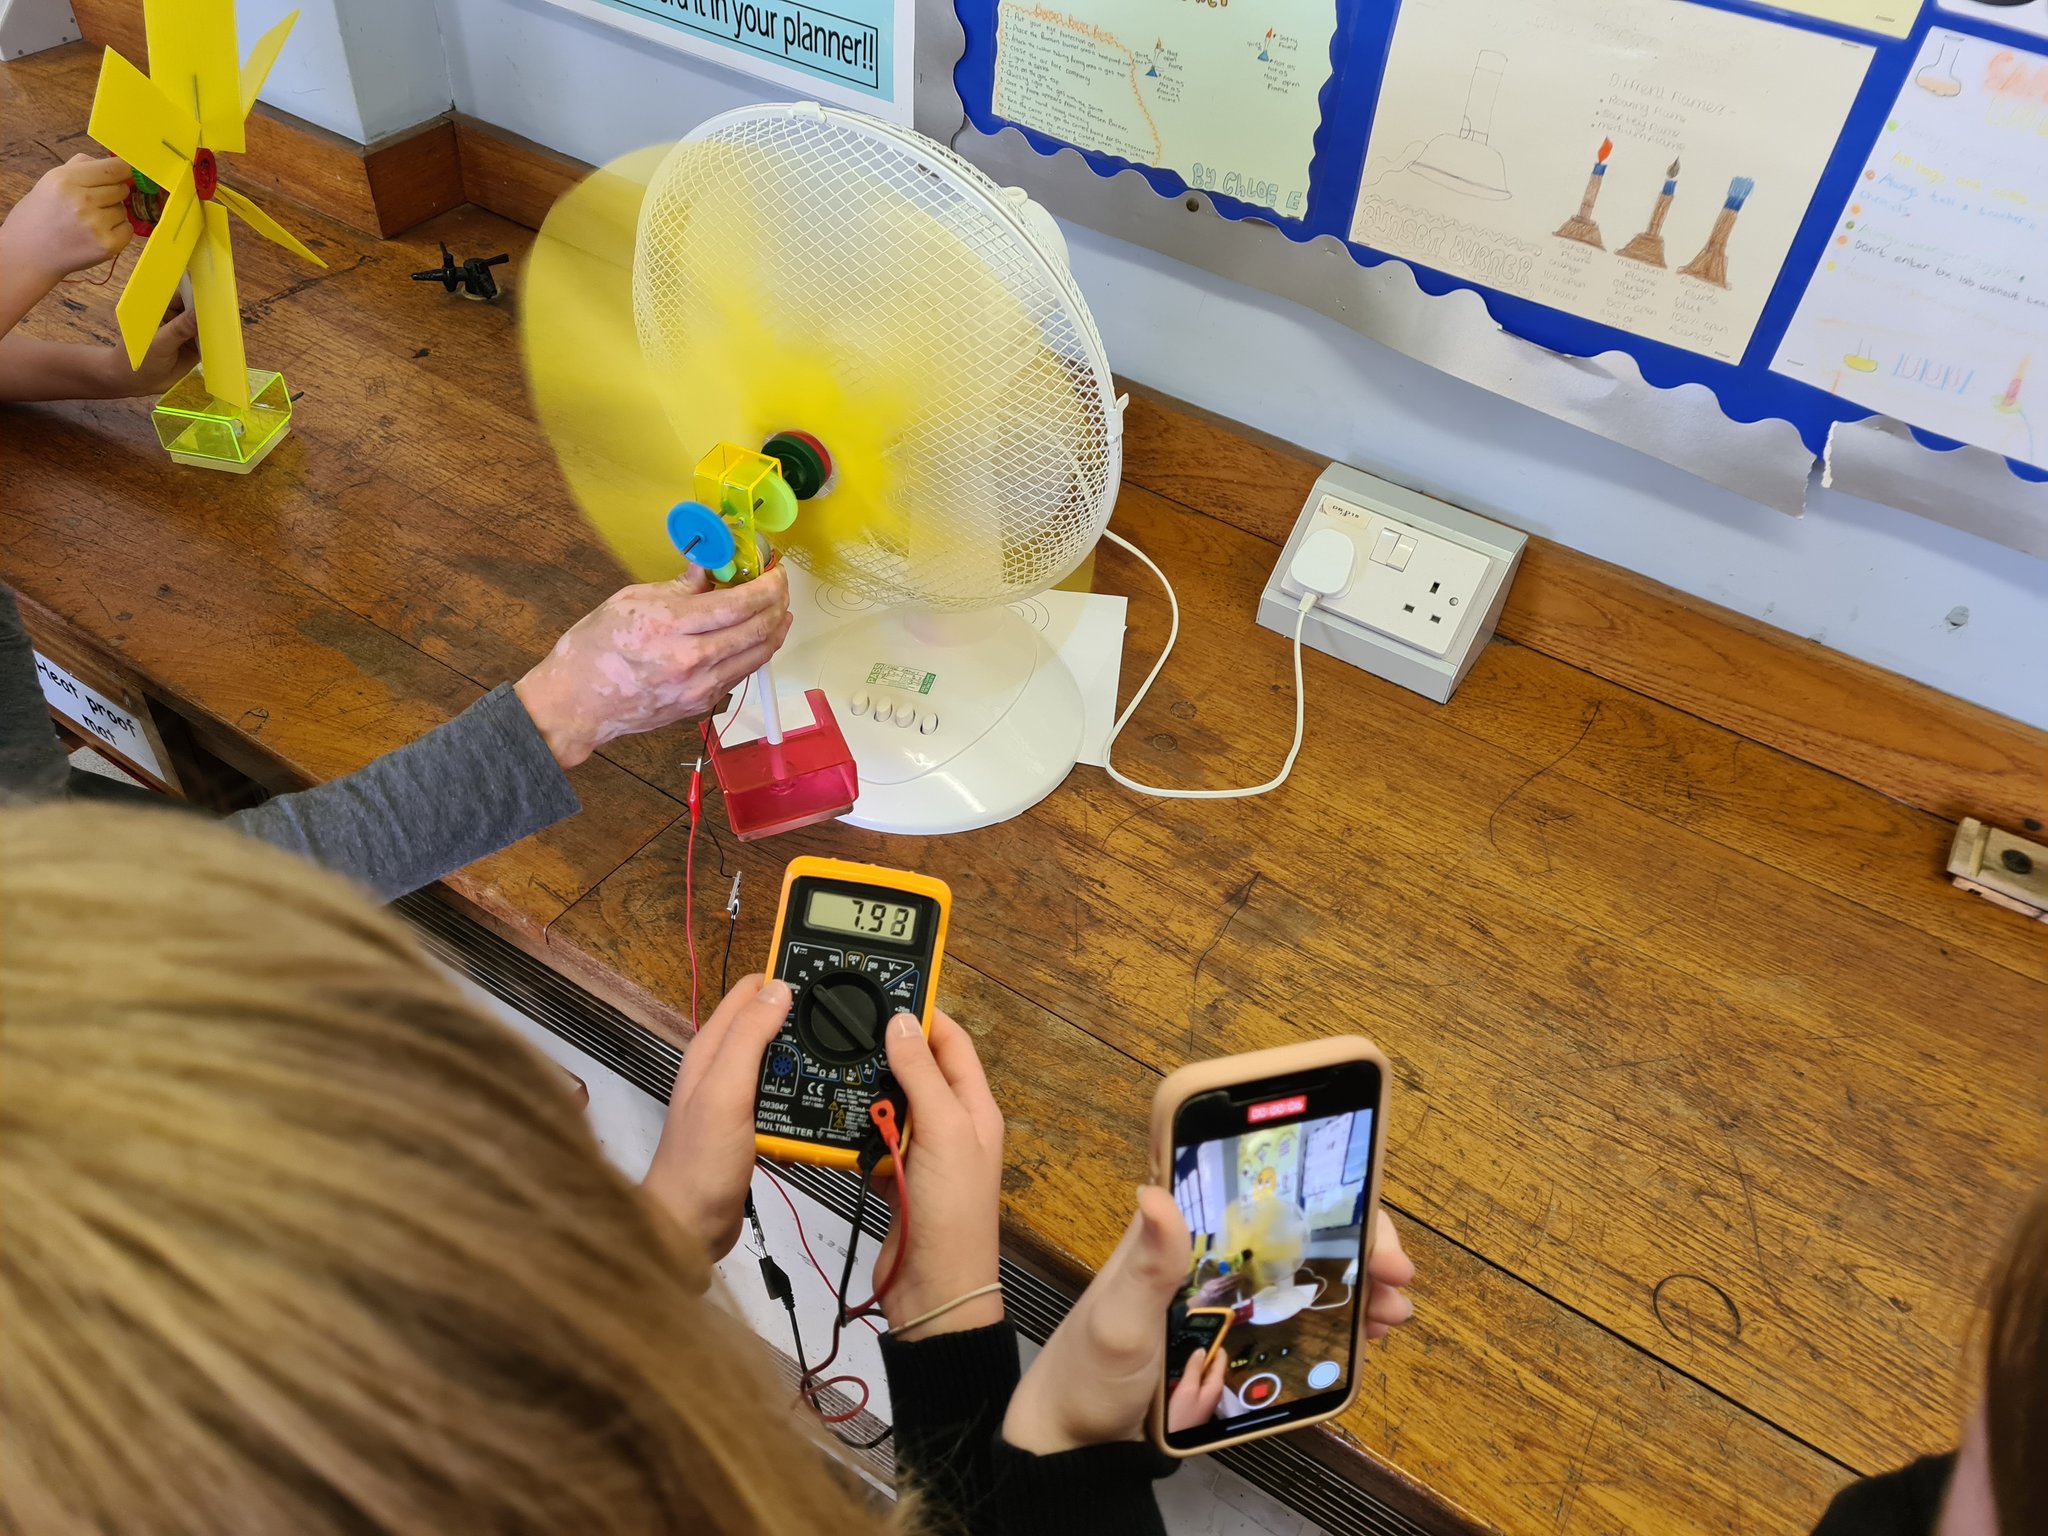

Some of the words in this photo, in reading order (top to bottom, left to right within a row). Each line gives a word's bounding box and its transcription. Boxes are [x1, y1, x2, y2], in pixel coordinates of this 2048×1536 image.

[733, 0, 777, 39] your
[784, 10, 874, 71] planner!!
[1286, 191, 1302, 210] E
[36, 661, 79, 699] Heat
[85, 695, 137, 738] proof
[82, 714, 117, 746] mat
[755, 1120, 814, 1137] MULTIMETER
[757, 1110, 792, 1124] DIGITAL
